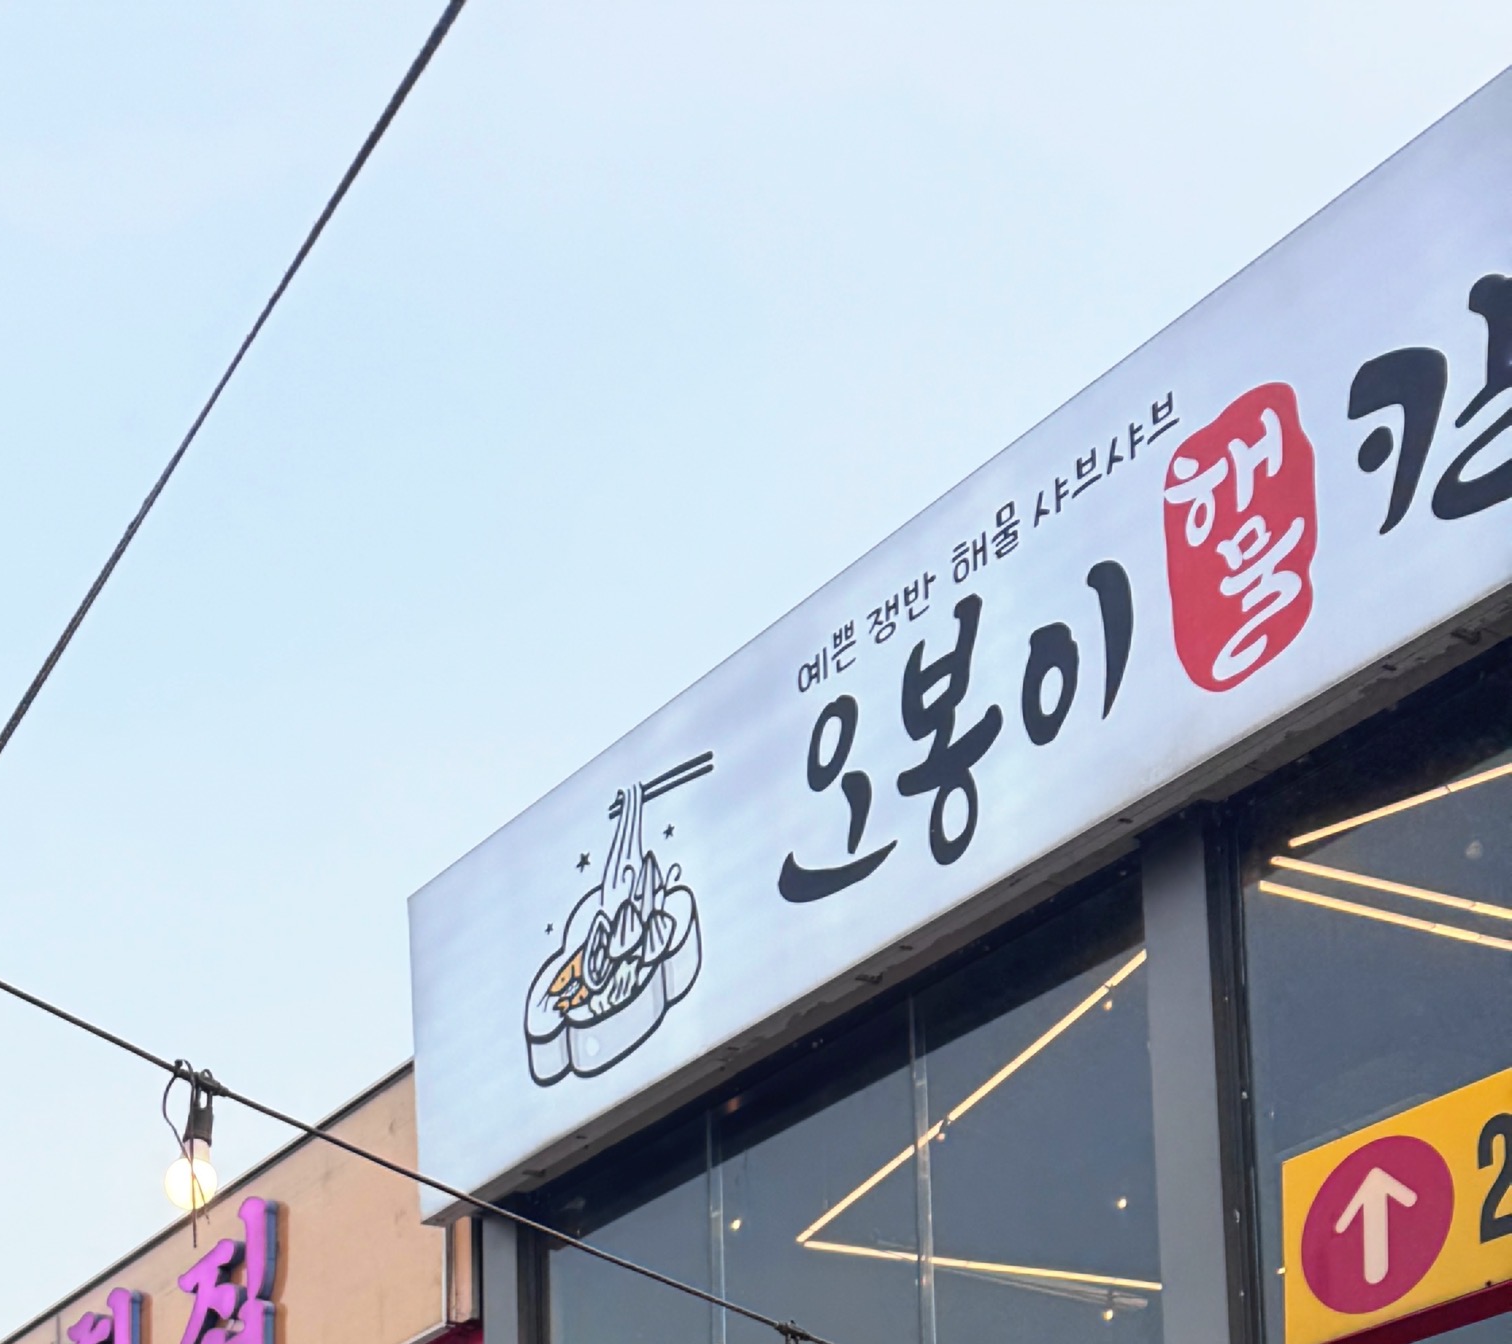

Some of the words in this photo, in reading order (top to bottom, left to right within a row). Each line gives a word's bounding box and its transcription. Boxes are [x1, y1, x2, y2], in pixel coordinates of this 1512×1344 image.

[797, 619, 857, 693] 예쁜
[866, 571, 937, 646] 쟁반
[951, 500, 1021, 585] 해물
[1032, 390, 1181, 528] 샤브샤브
[1163, 407, 1306, 682] 해물
[776, 559, 1135, 905] 오봉이
